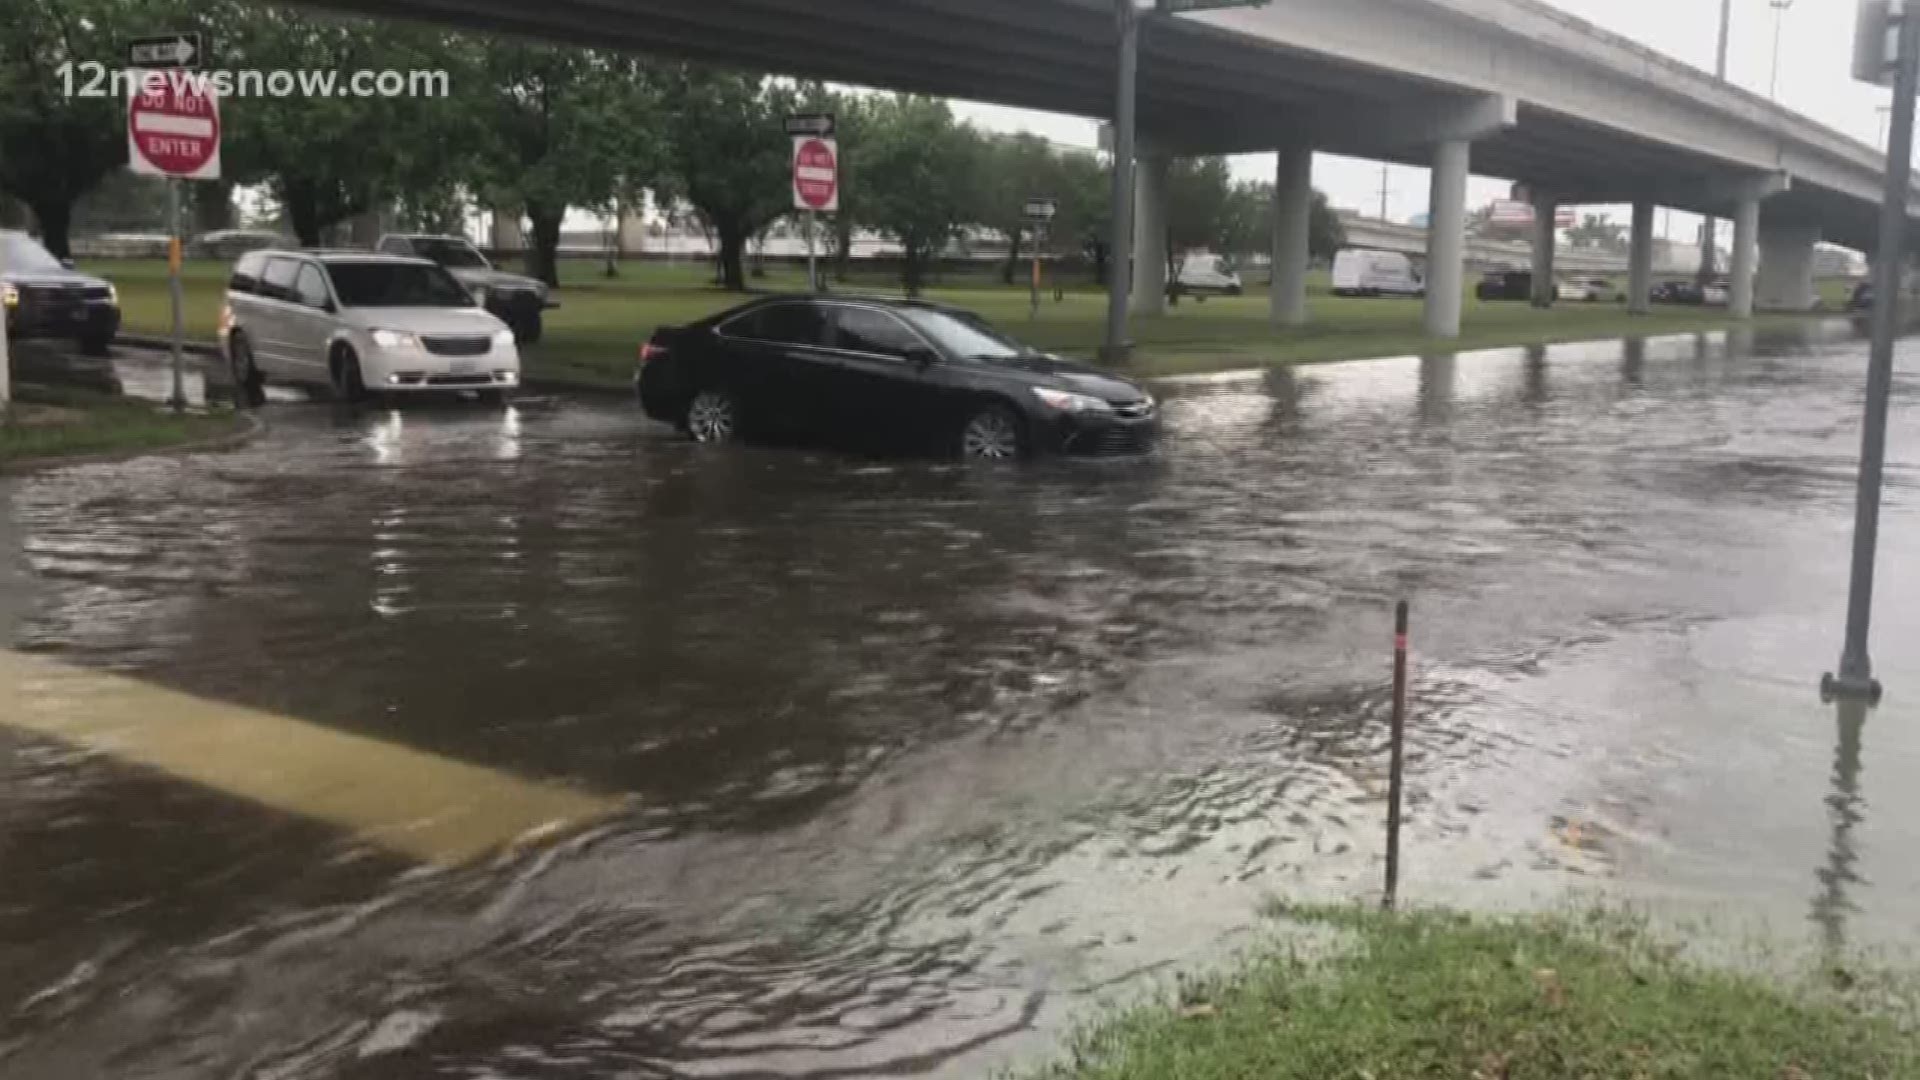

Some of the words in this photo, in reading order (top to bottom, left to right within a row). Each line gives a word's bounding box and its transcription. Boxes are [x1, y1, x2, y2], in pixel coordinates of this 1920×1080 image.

[143, 93, 166, 109] DO
[173, 95, 205, 113] NOT
[148, 136, 202, 157] ENTER
